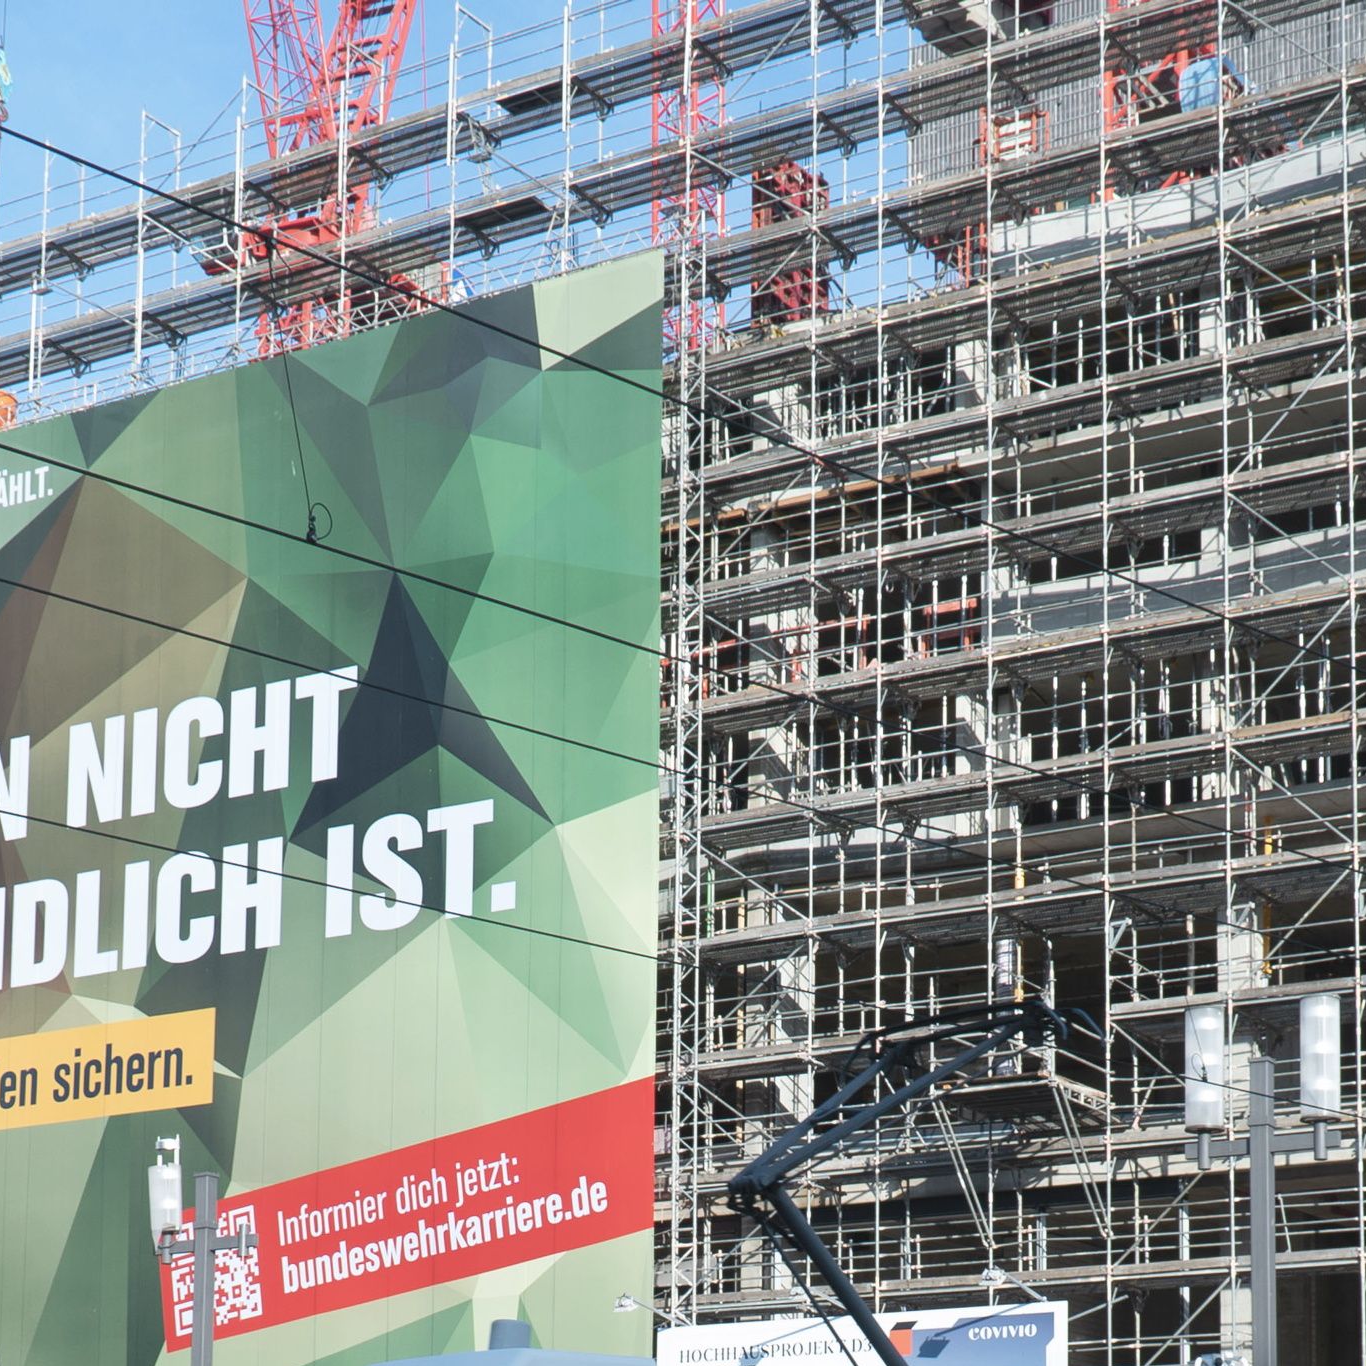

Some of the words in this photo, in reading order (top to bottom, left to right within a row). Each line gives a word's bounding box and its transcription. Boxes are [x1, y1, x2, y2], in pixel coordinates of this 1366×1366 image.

[66, 666, 358, 827] NICHT
[325, 799, 517, 940] IST.
[52, 1042, 194, 1102] sichern.
[277, 1190, 387, 1247] Informier
[395, 1168, 447, 1215] dich
[455, 1153, 520, 1208] jetzt:
[281, 1175, 609, 1294] bundeswehrkarriere.de
[679, 1338, 846, 1364] HOCHHAUSPROJEKT
[968, 1323, 1038, 1341] COVIVIO
